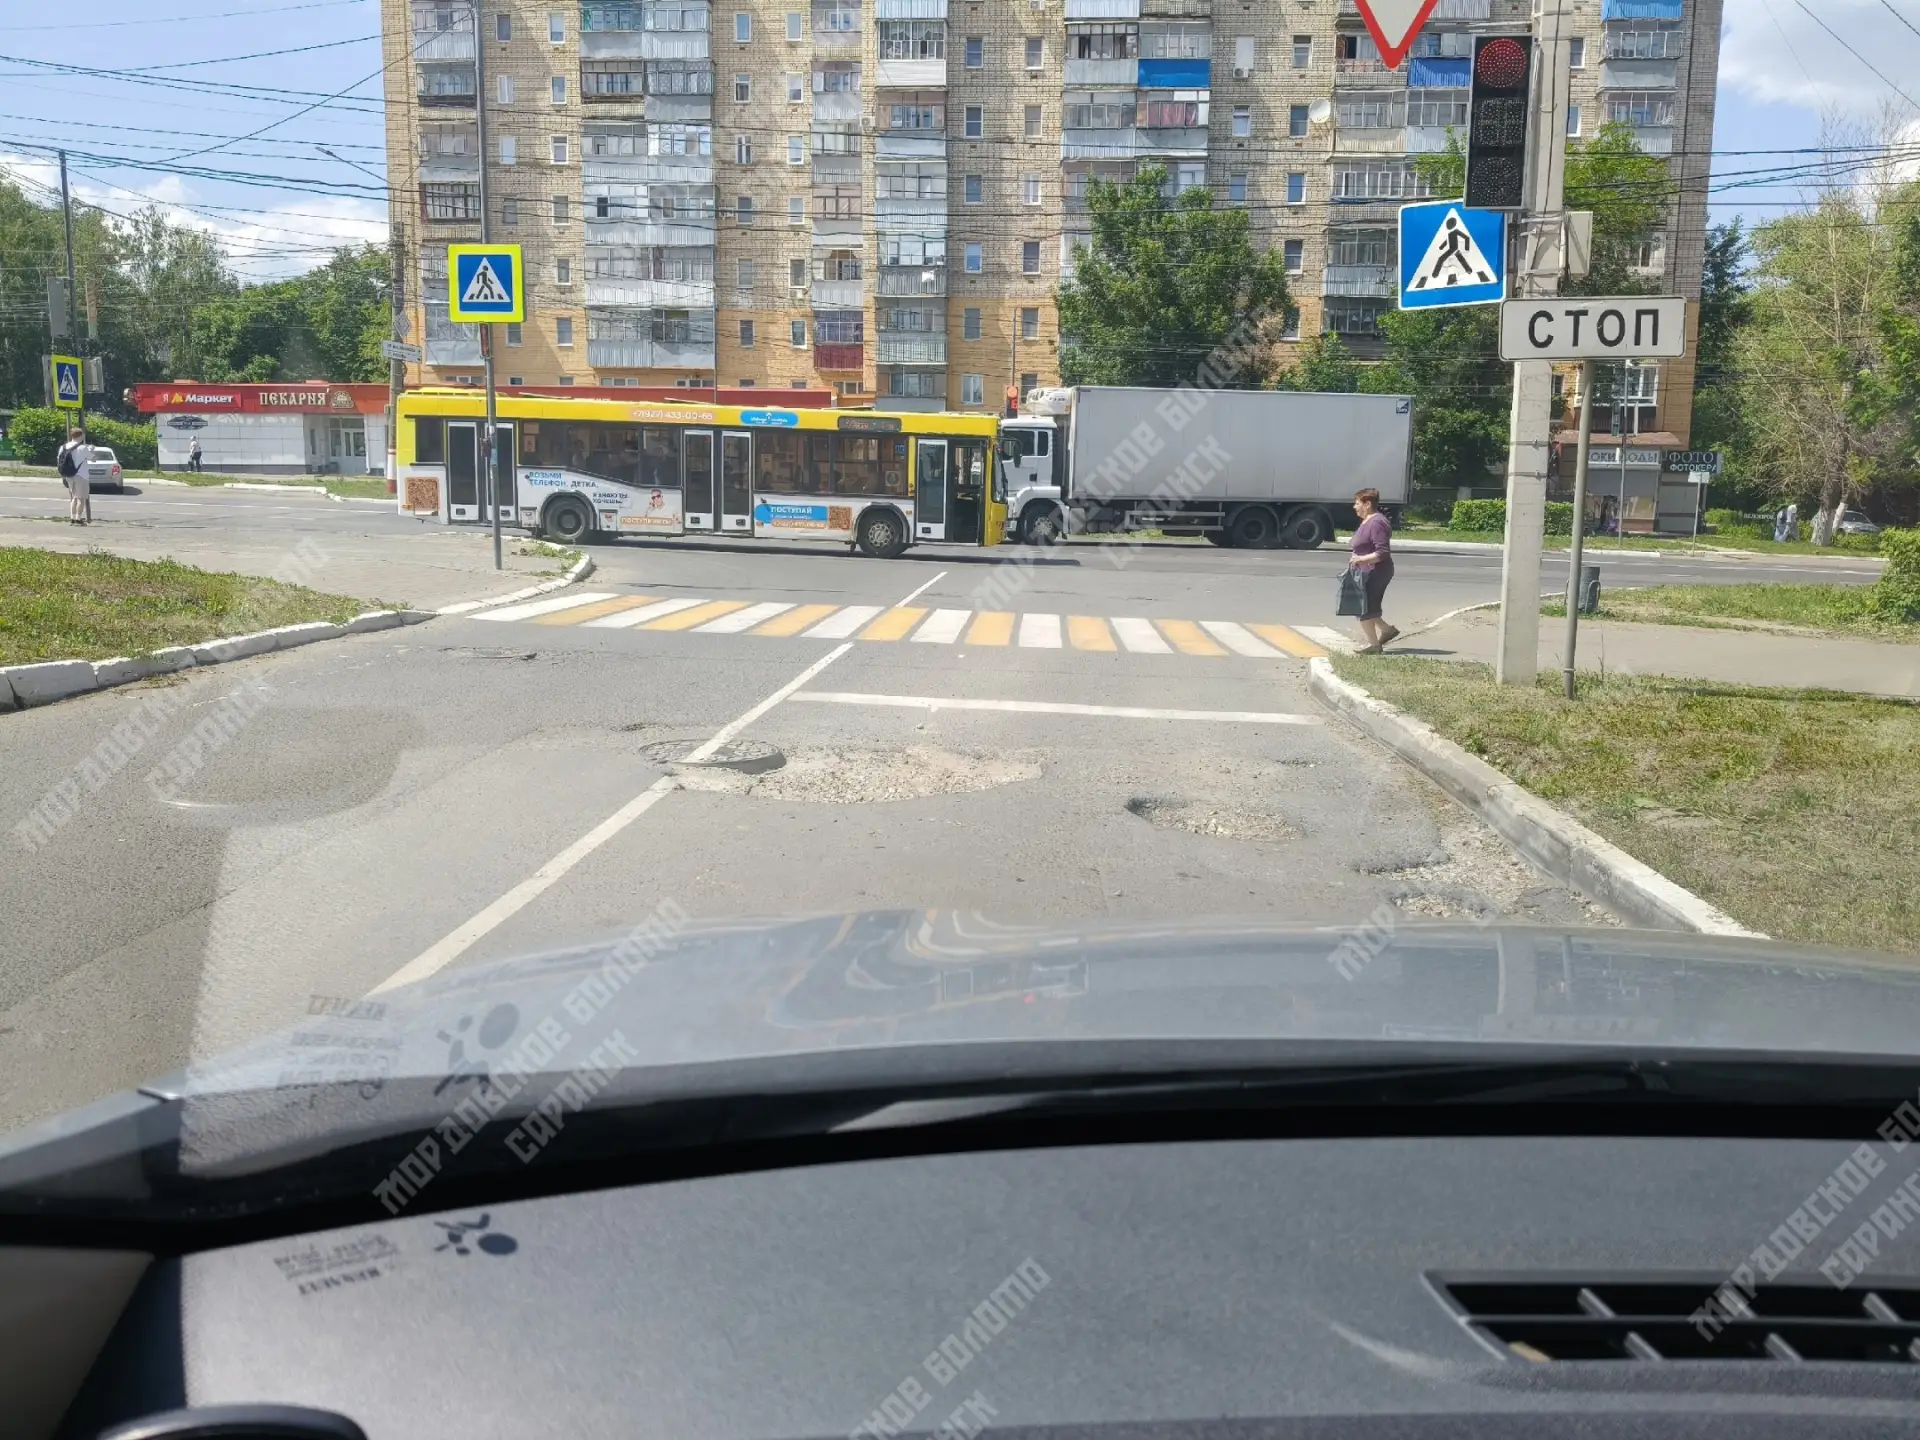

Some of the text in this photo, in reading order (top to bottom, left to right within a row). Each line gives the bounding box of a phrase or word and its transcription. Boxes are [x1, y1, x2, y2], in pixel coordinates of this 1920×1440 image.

[1527, 308, 1660, 350] СТОП
[184, 393, 234, 404] Маркет
[258, 392, 327, 406] ПЕКАРНЯ
[1590, 452, 1658, 463] ОКИ ОДЫ
[1669, 451, 1714, 464] ФОТО
[529, 471, 562, 480] ВОЗЬМИ
[770, 506, 813, 515] ПОСТУПАЙ
